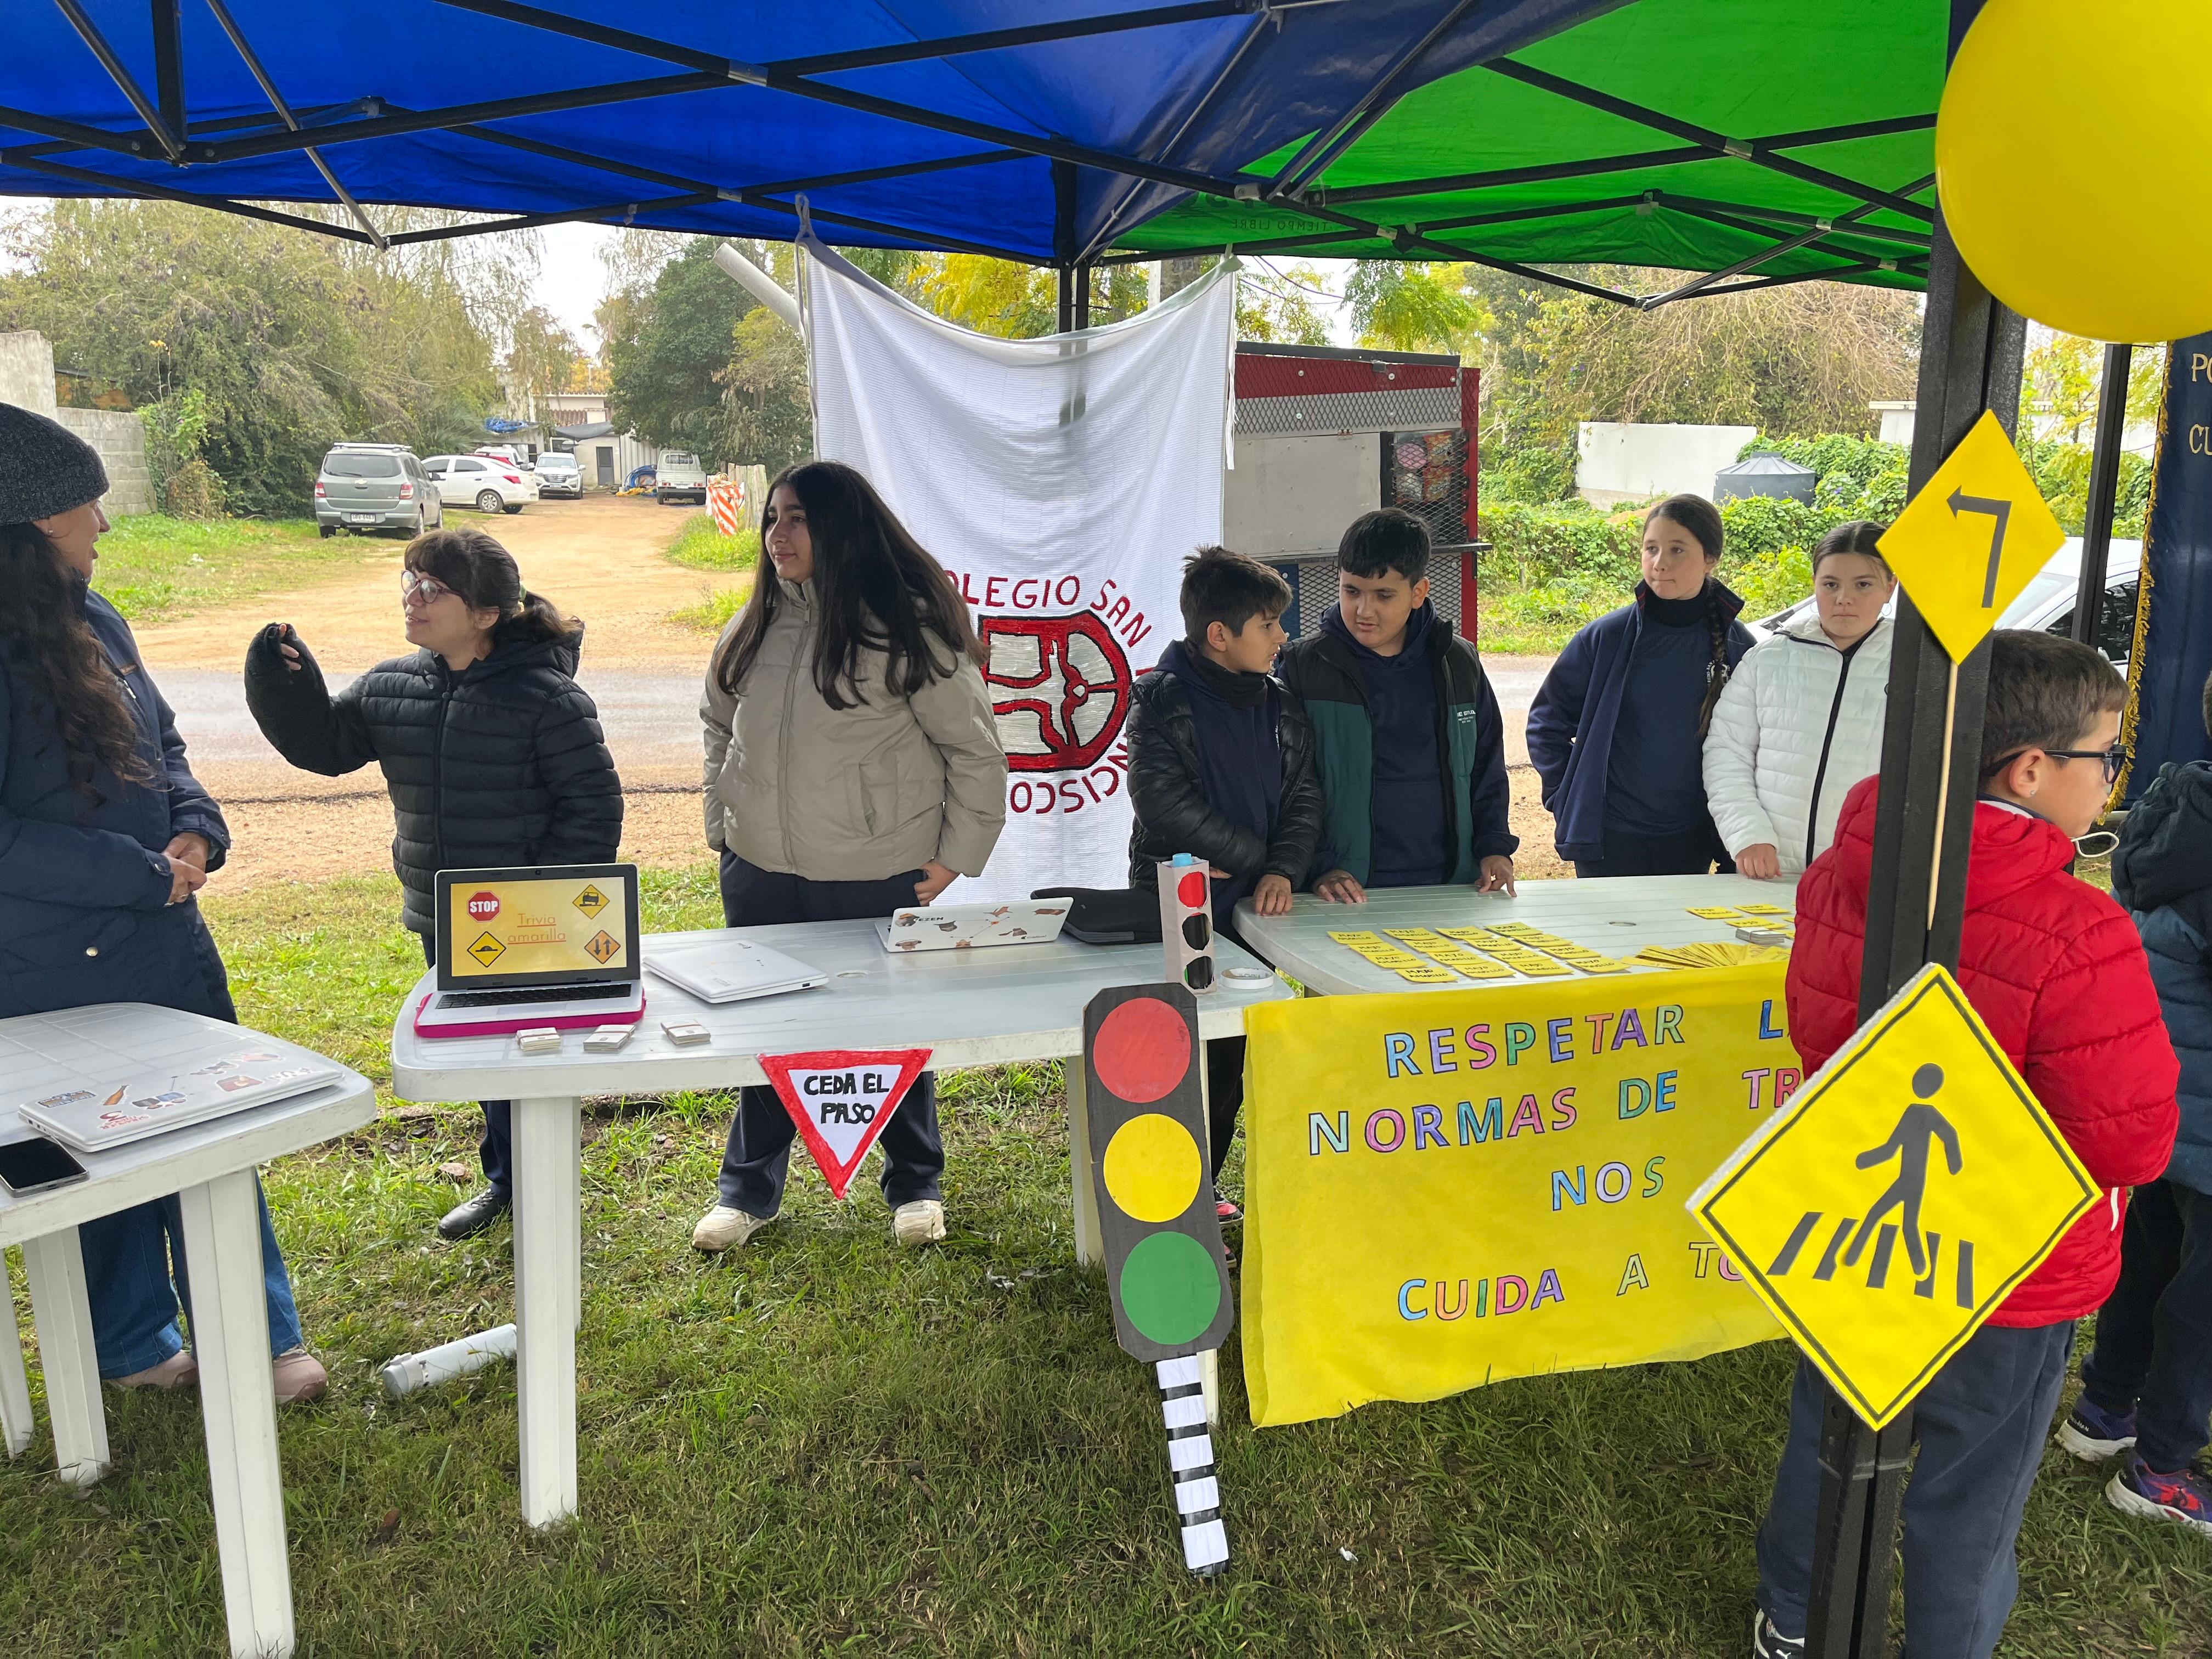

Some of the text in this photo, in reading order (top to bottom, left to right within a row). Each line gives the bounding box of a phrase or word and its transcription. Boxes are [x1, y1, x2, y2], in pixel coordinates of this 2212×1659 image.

[2191, 353, 2212, 384] P
[943, 569, 1152, 648] LEGIO SAN
[470, 900, 498, 913] STOP
[518, 913, 556, 925] Trivia
[507, 928, 566, 943] amarilla
[1384, 1003, 1684, 1078] RESPETAR
[804, 1073, 890, 1096] CEDA EL
[821, 1102, 875, 1124] PASO
[1308, 1068, 1801, 1156] NORMAS DE TR
[1551, 1156, 1665, 1211] NOS
[1398, 1242, 1743, 1321] CUIDA A TO
